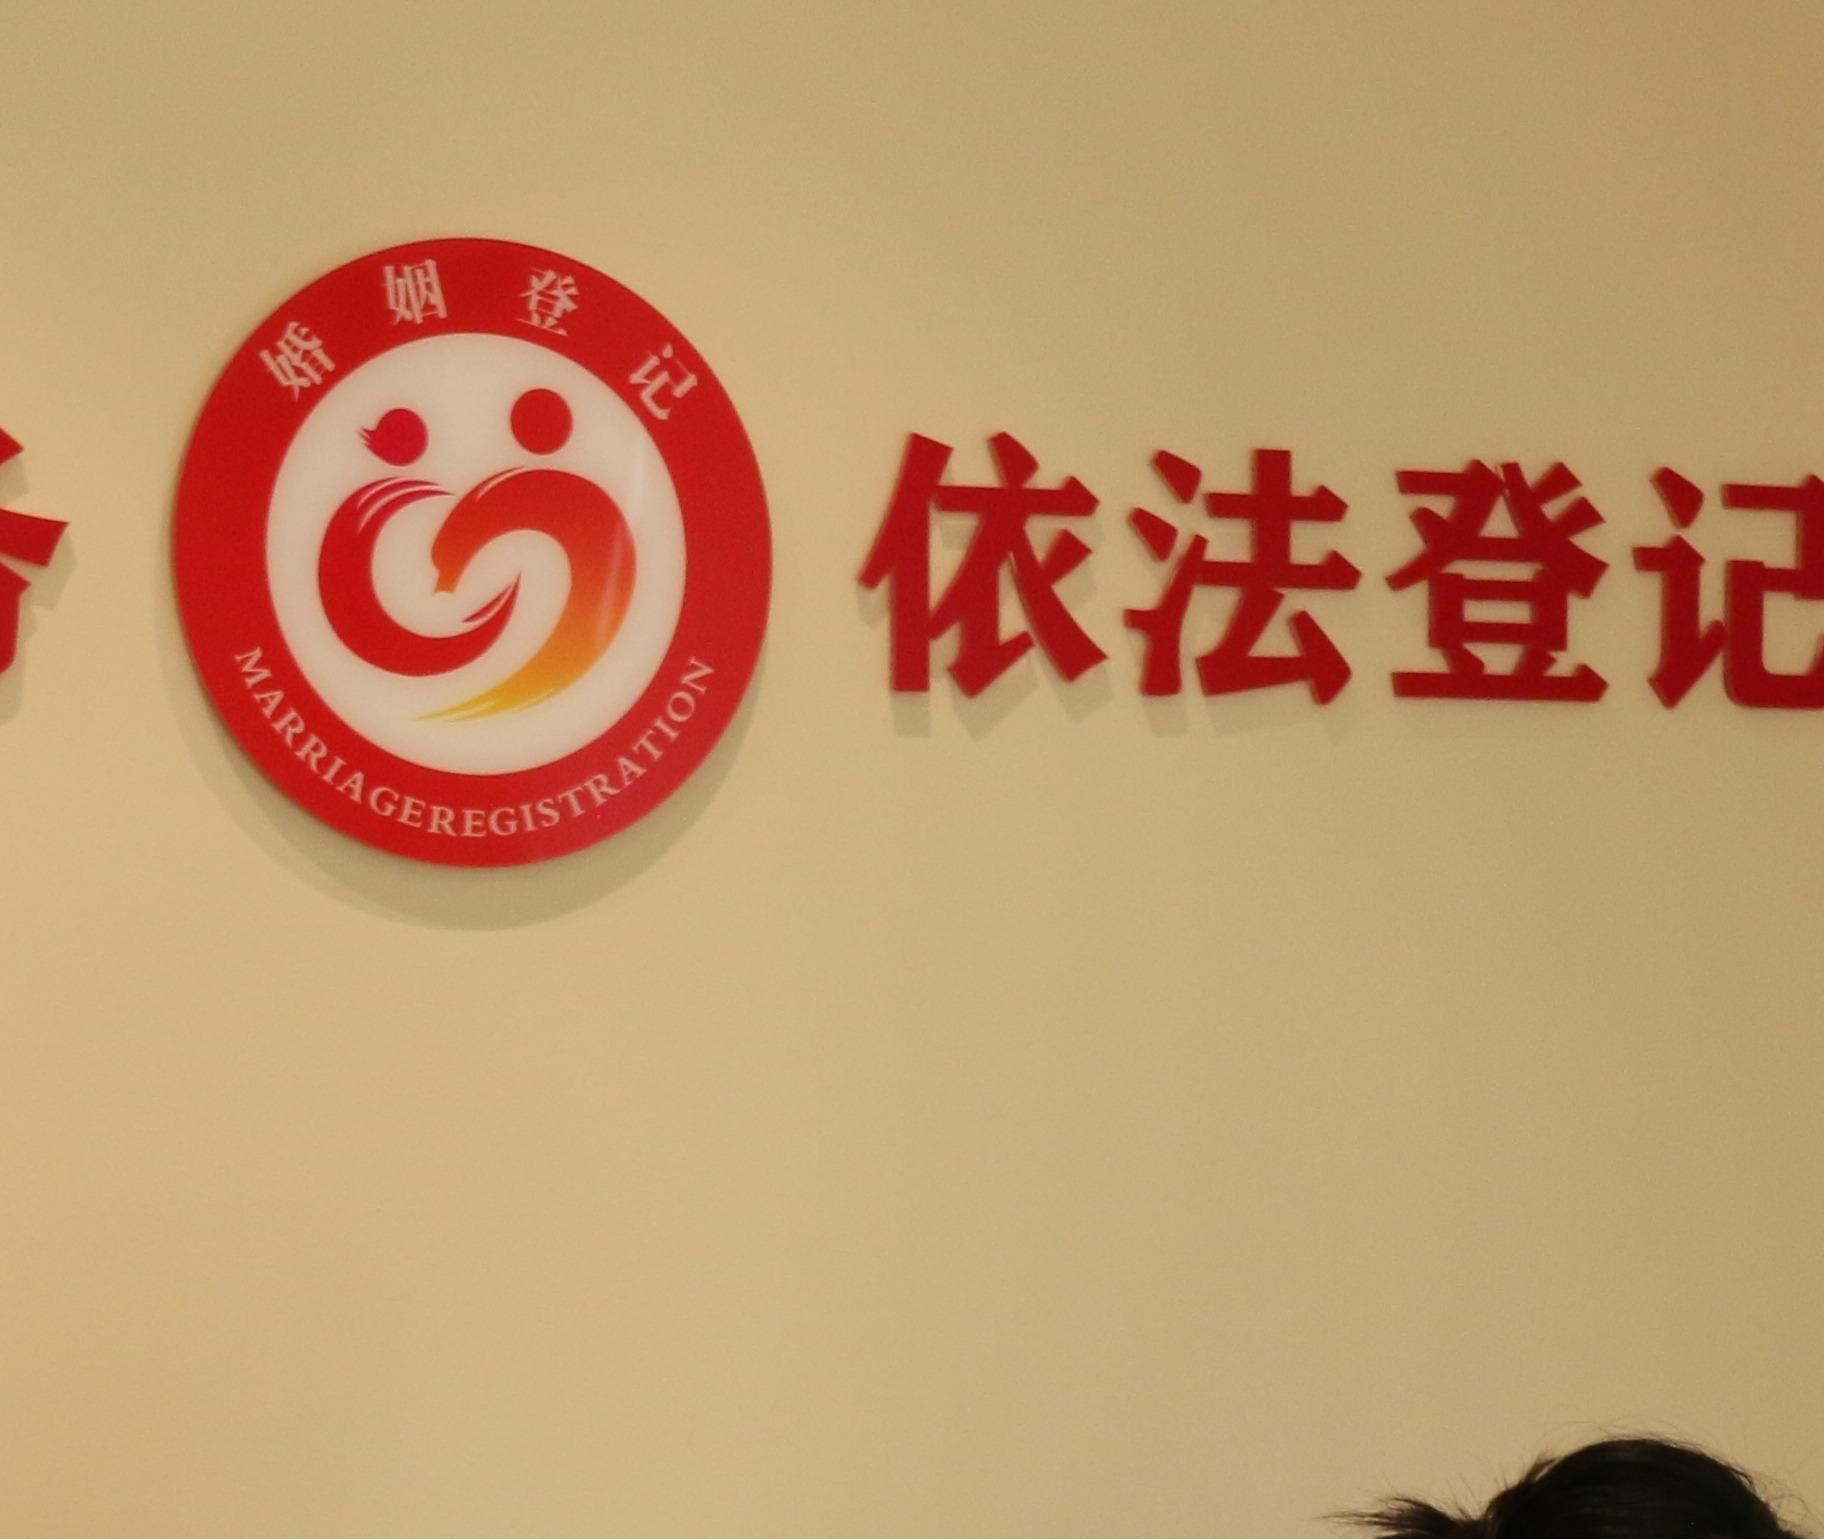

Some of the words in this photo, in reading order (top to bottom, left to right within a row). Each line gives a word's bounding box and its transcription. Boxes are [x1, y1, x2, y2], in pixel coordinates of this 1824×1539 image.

[260, 258, 698, 421] 婚姻登记
[235, 646, 715, 838] MARRIAGEREGISTRATION
